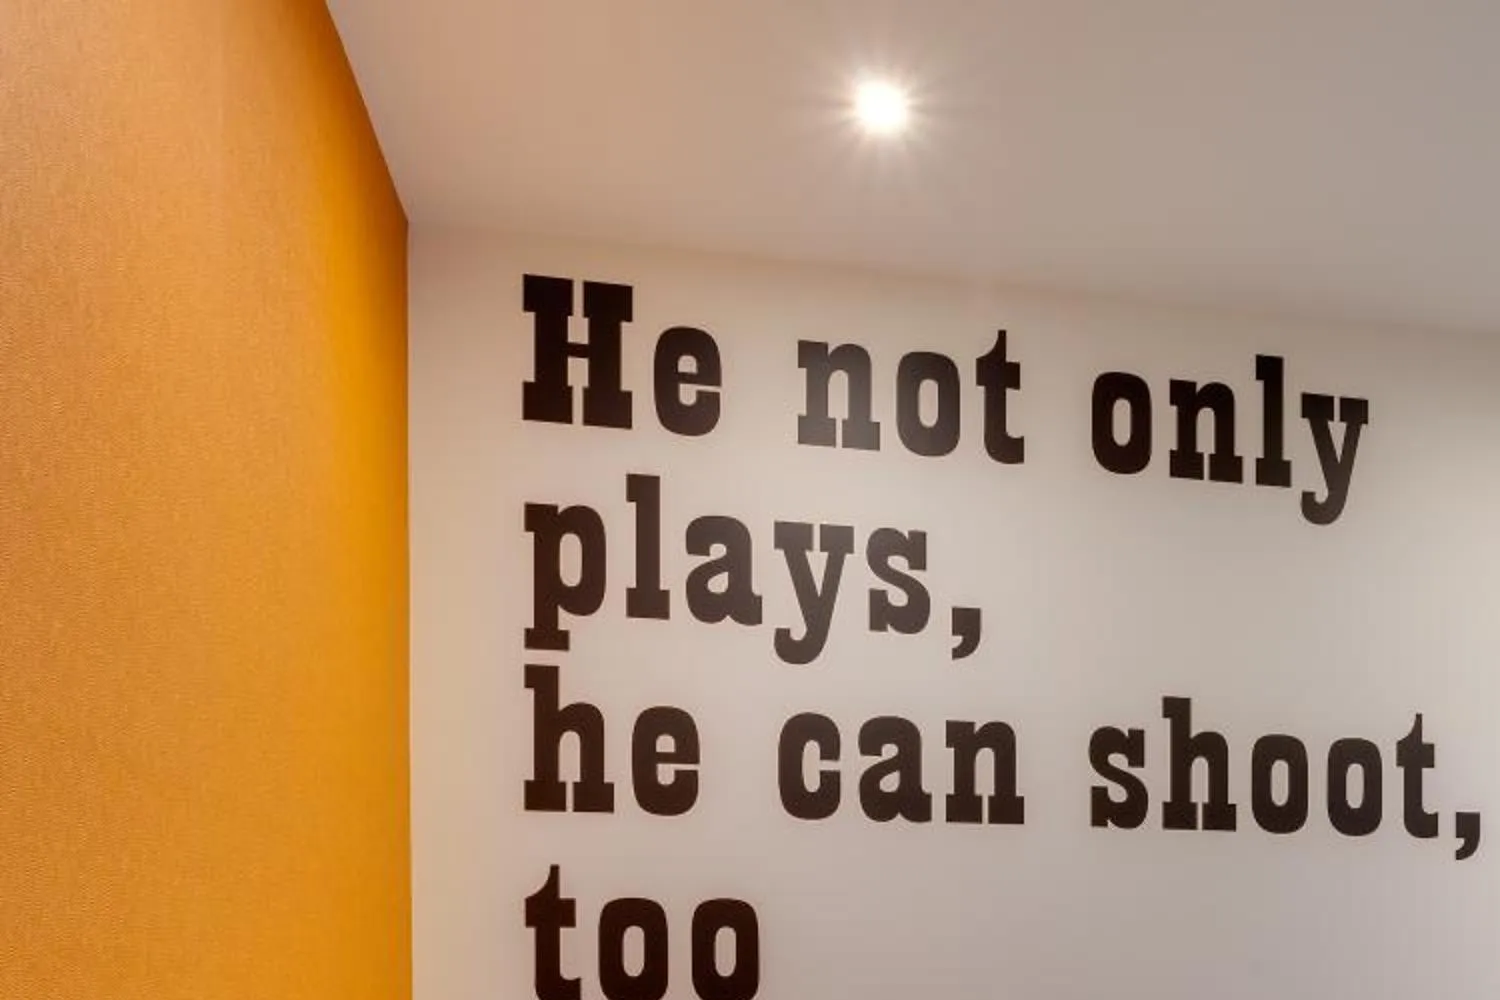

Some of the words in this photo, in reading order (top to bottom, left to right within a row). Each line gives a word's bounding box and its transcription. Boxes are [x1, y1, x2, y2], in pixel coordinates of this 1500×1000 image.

[522, 273, 721, 437] He
[798, 330, 1025, 464] not
[1092, 353, 1370, 526] only
[524, 474, 981, 665] plays,
[524, 664, 701, 817] he
[778, 713, 1025, 825] can
[1089, 695, 1481, 861] shoot,
